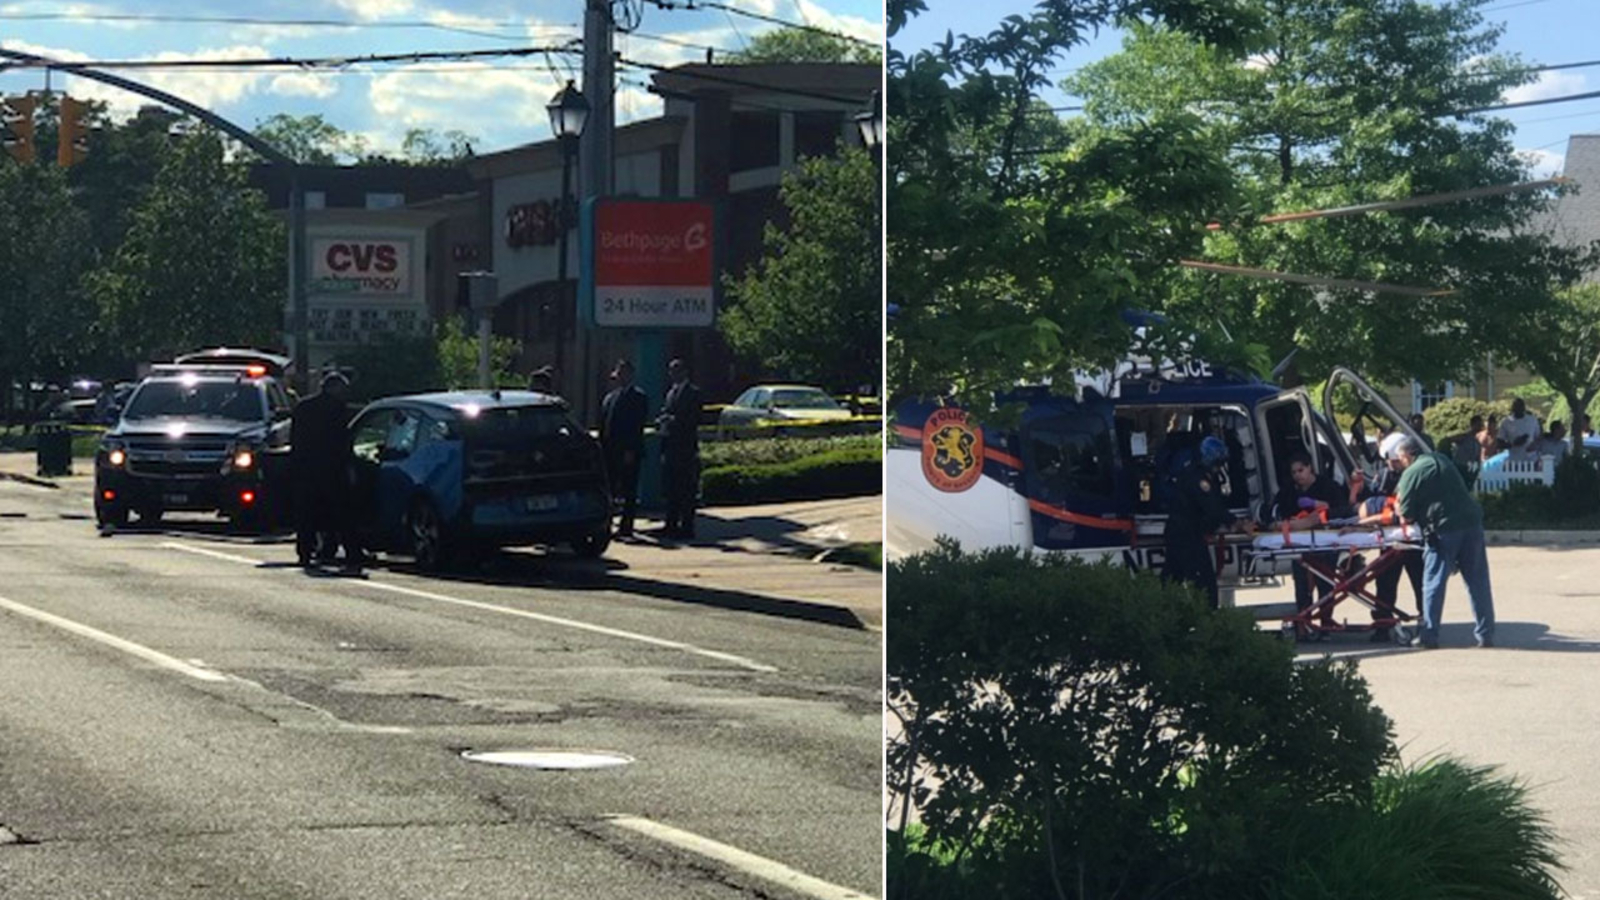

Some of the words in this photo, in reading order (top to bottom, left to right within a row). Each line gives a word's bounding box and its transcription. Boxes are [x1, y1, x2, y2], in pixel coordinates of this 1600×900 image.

[601, 230, 682, 252] Bethpage
[326, 243, 398, 272] CVS
[322, 273, 400, 291] macy
[604, 298, 625, 313] 24
[629, 298, 668, 313] Hour
[673, 298, 707, 313] ATM
